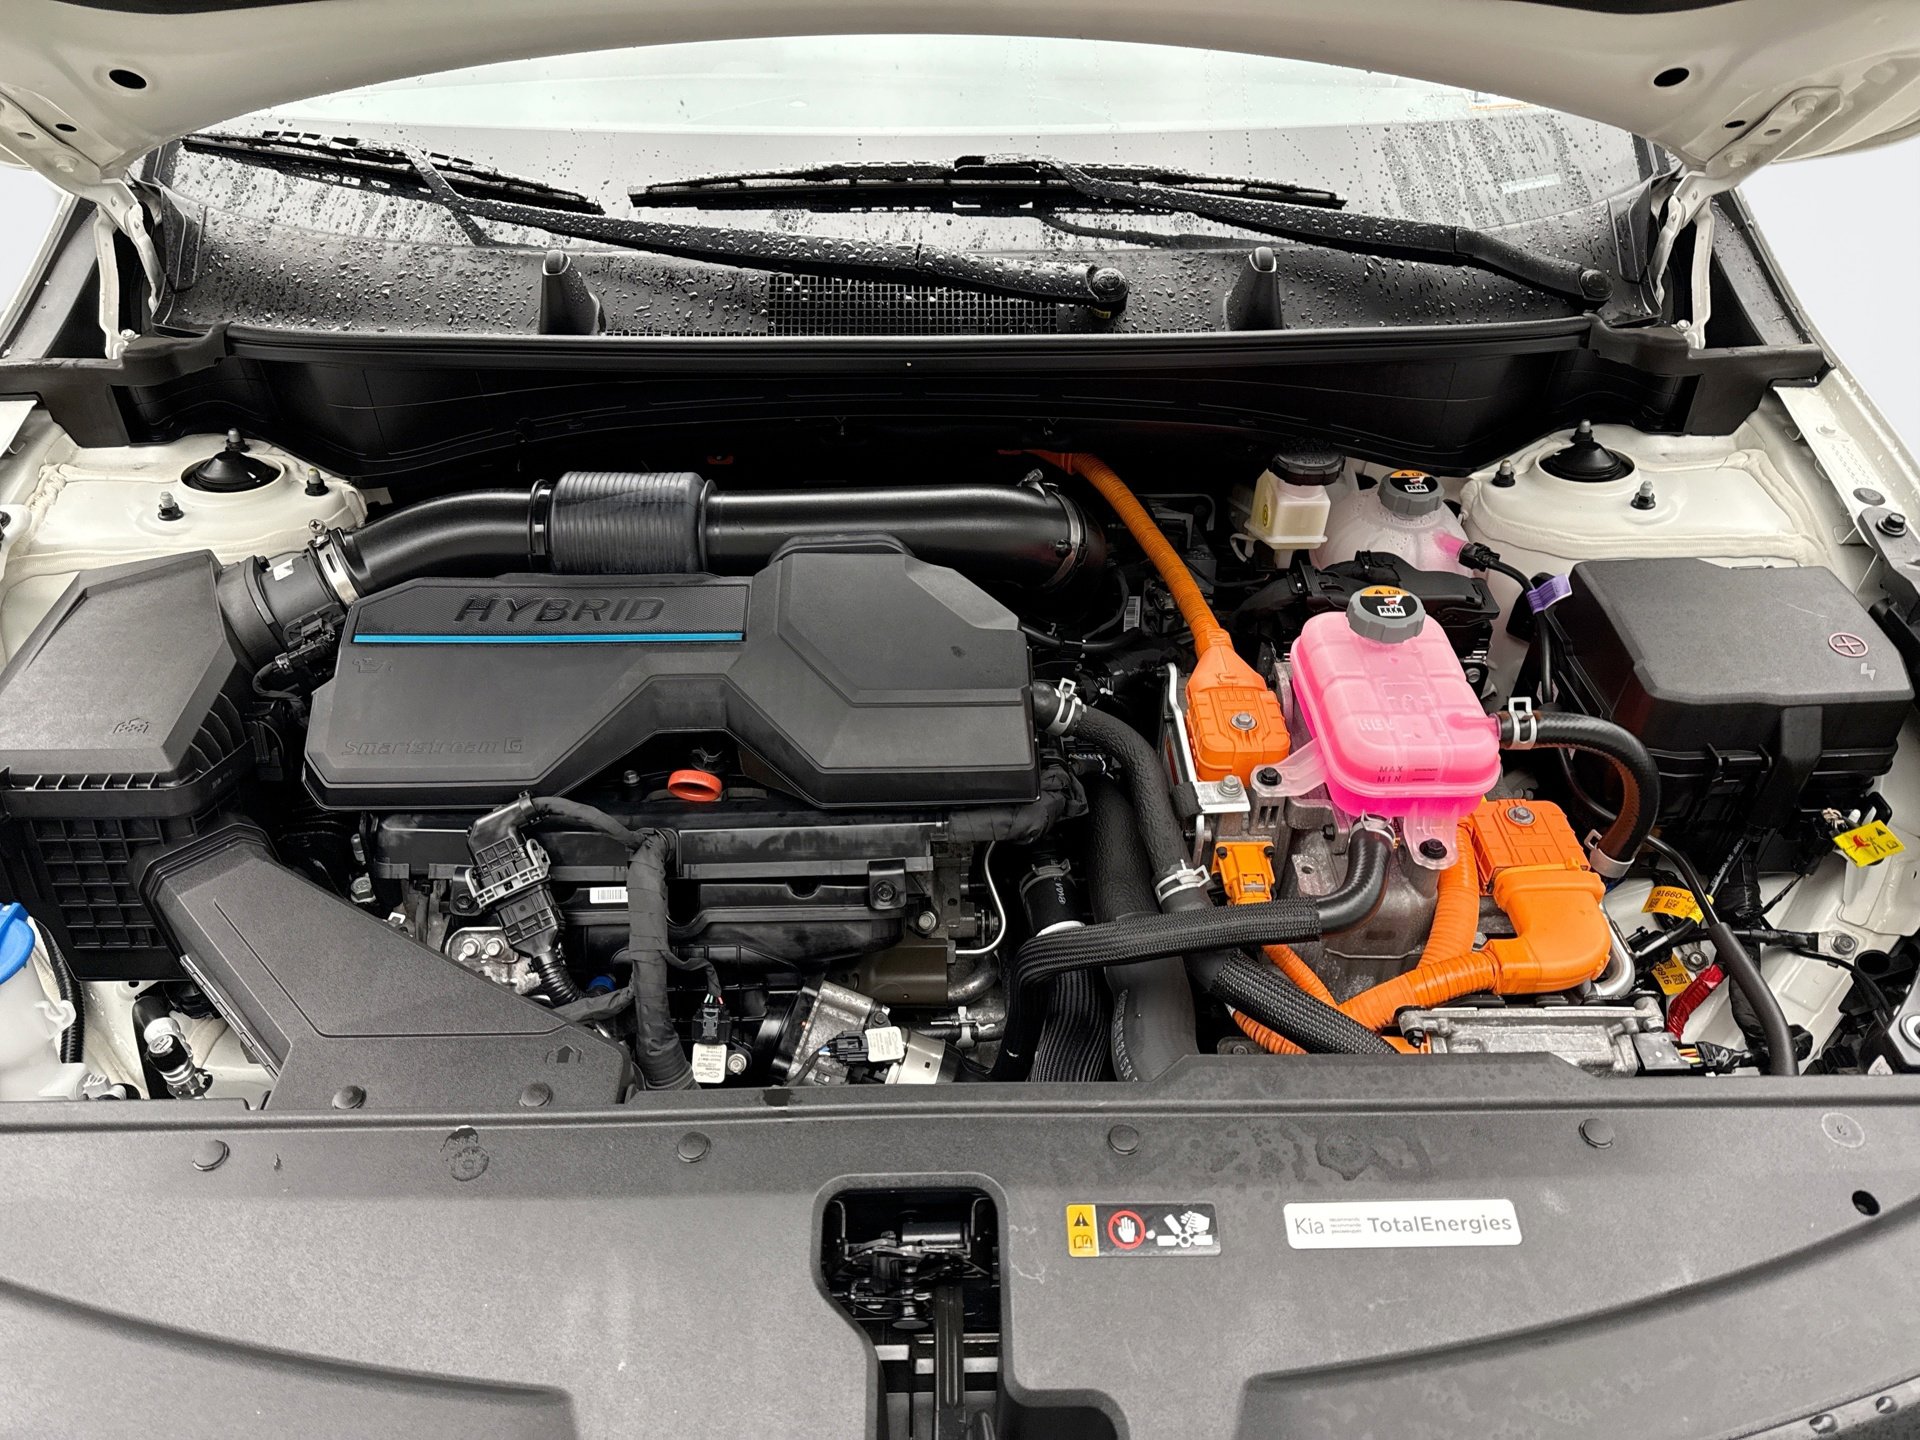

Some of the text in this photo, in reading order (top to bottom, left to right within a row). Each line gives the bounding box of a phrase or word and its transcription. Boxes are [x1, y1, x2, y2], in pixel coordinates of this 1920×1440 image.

[454, 597, 665, 622] HYBRID
[1379, 765, 1404, 773] MAX
[1377, 775, 1402, 783] MIN
[1655, 889, 1695, 904] 91660-C
[1294, 1217, 1325, 1235] Kia
[1366, 1213, 1512, 1235] TotalEnergies
